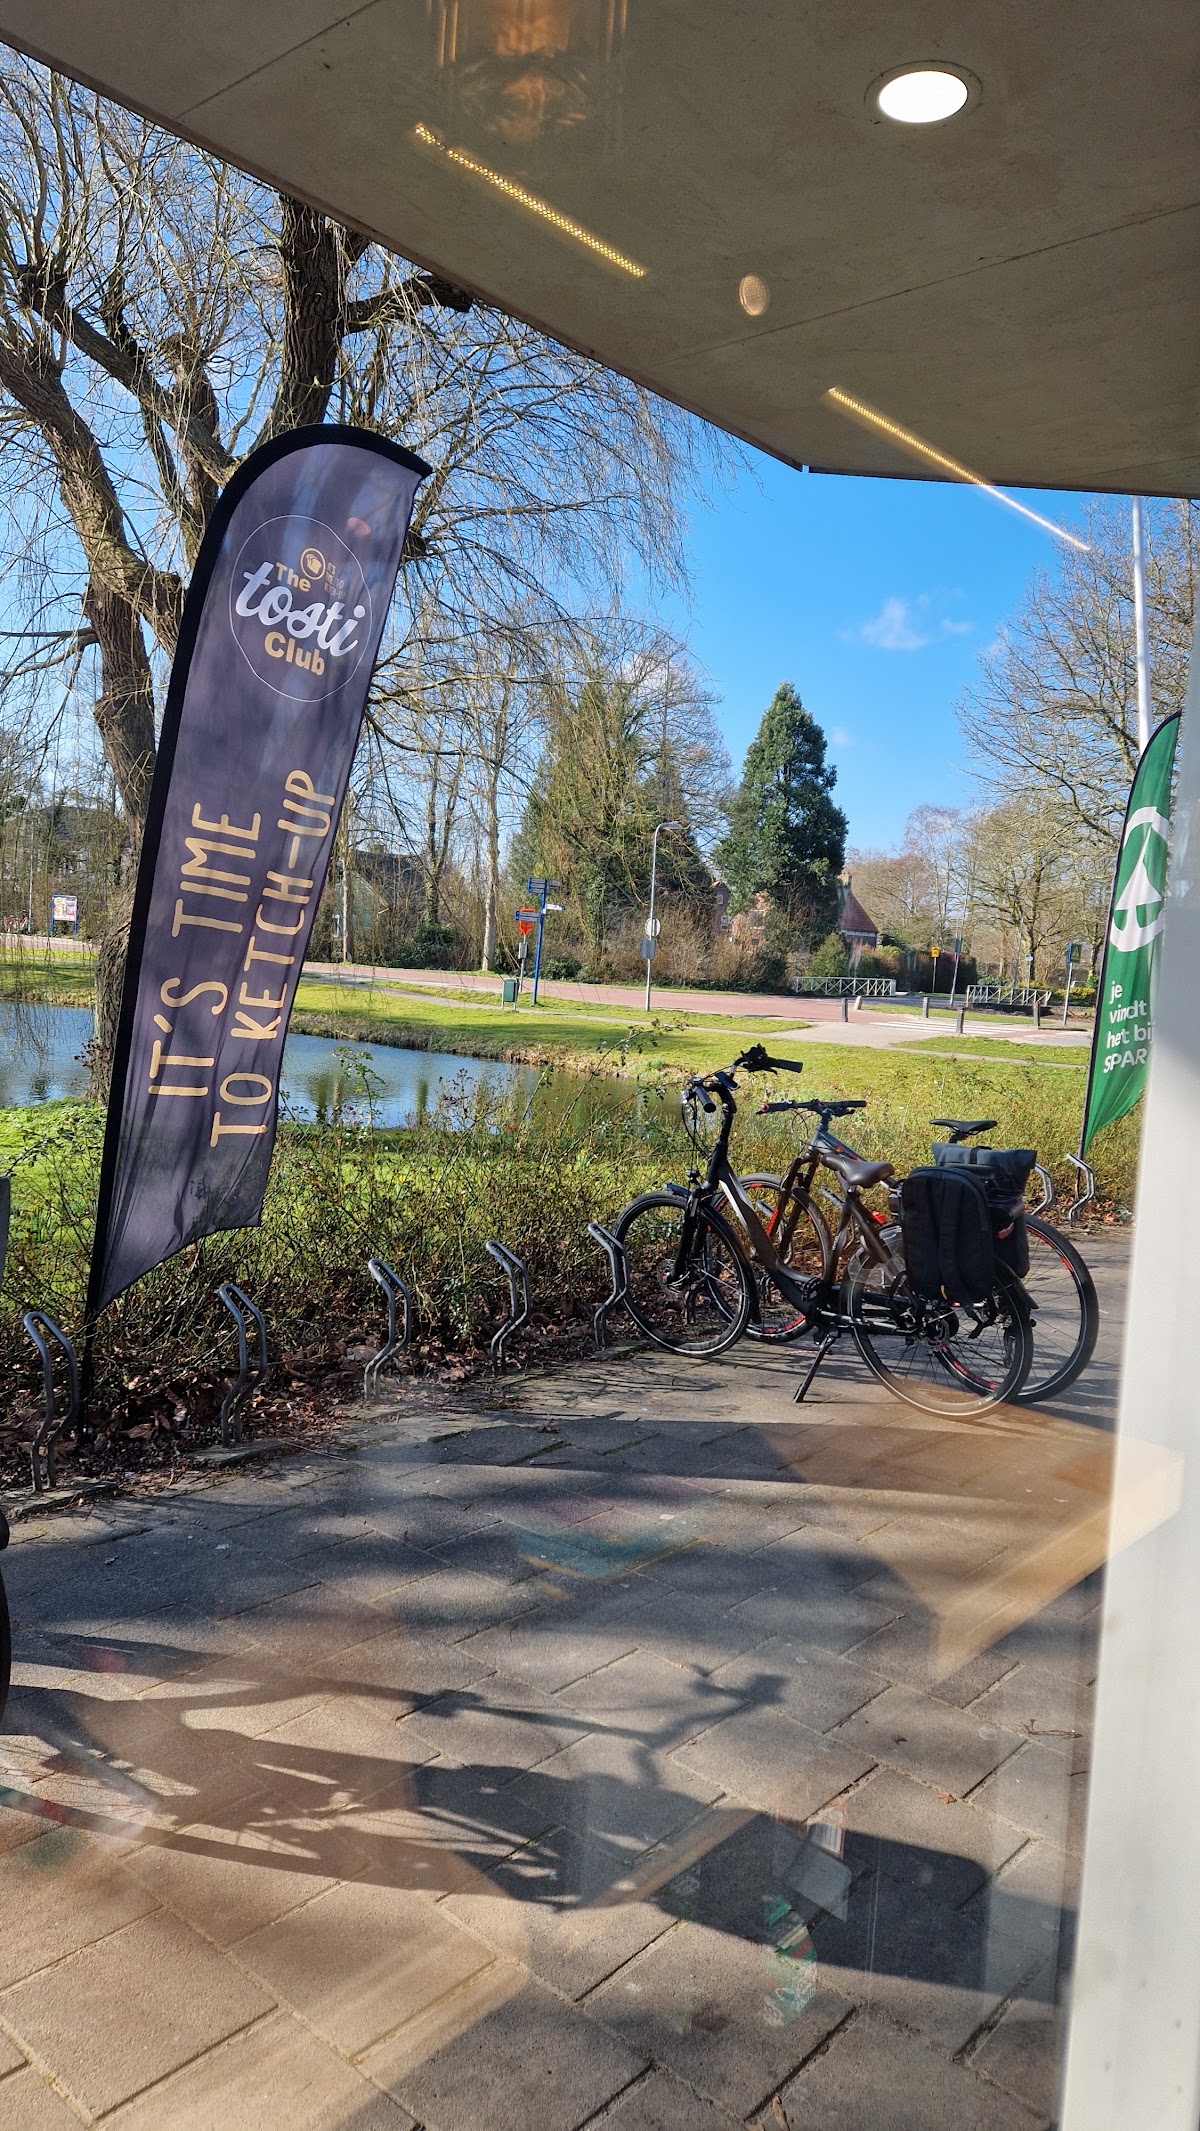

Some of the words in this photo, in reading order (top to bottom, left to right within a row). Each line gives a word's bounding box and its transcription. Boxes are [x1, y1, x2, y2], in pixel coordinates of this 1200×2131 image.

[275, 562, 312, 592] The
[235, 561, 366, 657] tosti
[264, 631, 325, 676] Club
[171, 802, 261, 938] TIME
[230, 769, 336, 1040] KETCH-UP
[1109, 981, 1123, 1004] je
[1109, 1000, 1147, 1024] vindt
[148, 977, 228, 1097] IT'S
[1106, 1029, 1130, 1049] het
[1103, 1048, 1147, 1073] SPAR
[209, 1072, 272, 1148] TO
